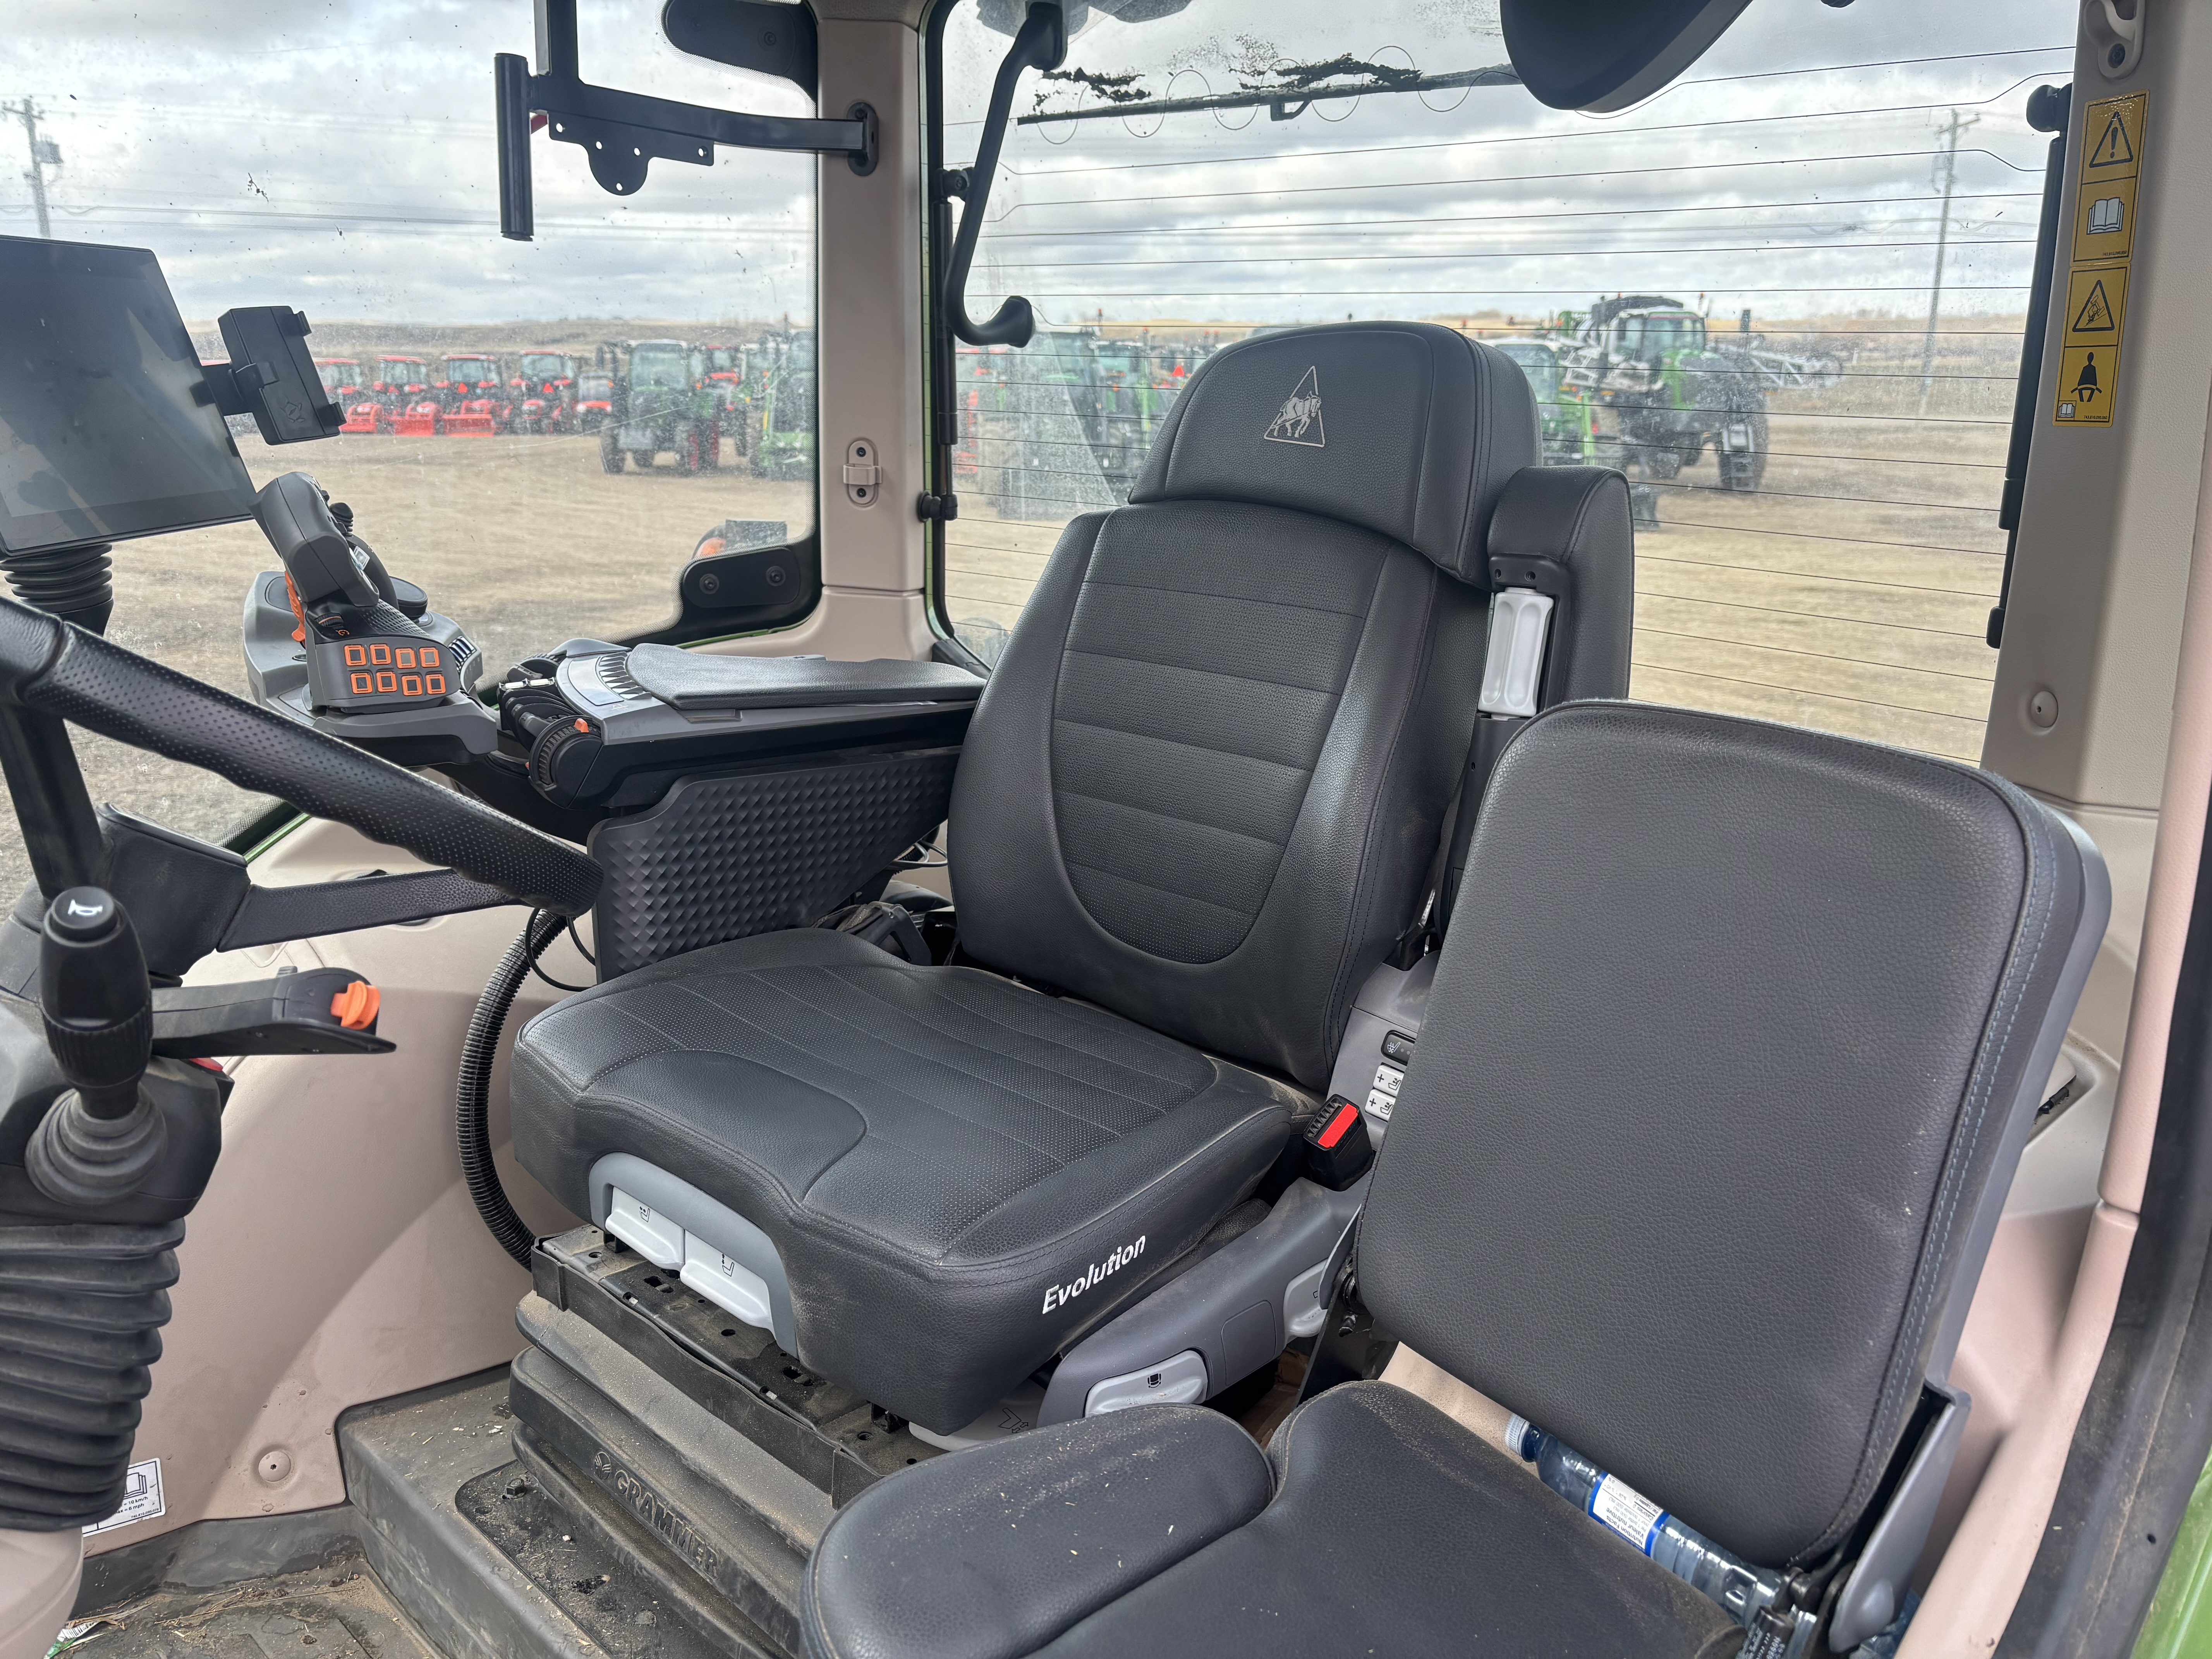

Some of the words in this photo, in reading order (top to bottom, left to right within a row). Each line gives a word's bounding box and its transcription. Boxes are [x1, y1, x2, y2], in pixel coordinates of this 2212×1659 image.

[1042, 1235, 1146, 1314] Evolution
[615, 1470, 720, 1580] GRAMMER
[1606, 1508, 1627, 1525] nutritive
[1606, 1515, 1620, 1529] Facts
[1621, 1526, 1643, 1546] Nutrition
[1628, 1524, 1644, 1539] Valeur
